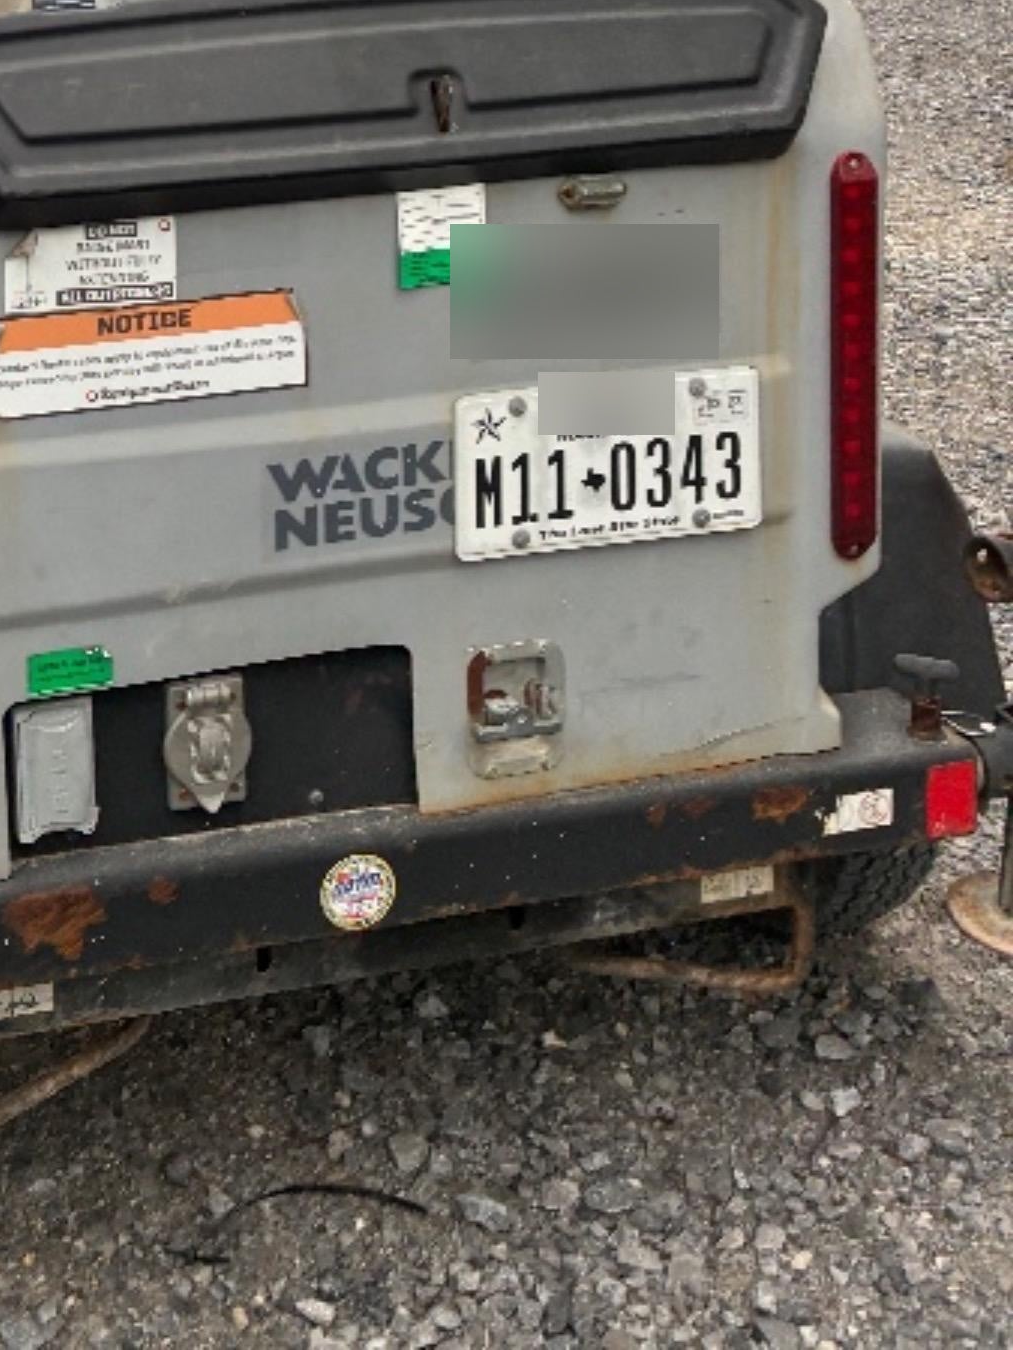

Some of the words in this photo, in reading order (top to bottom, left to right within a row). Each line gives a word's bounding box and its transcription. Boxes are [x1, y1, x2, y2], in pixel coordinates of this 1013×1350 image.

[97, 308, 193, 337] NOTICE
[266, 440, 454, 502] WACK
[475, 450, 574, 530] M11
[610, 432, 743, 511] 0343
